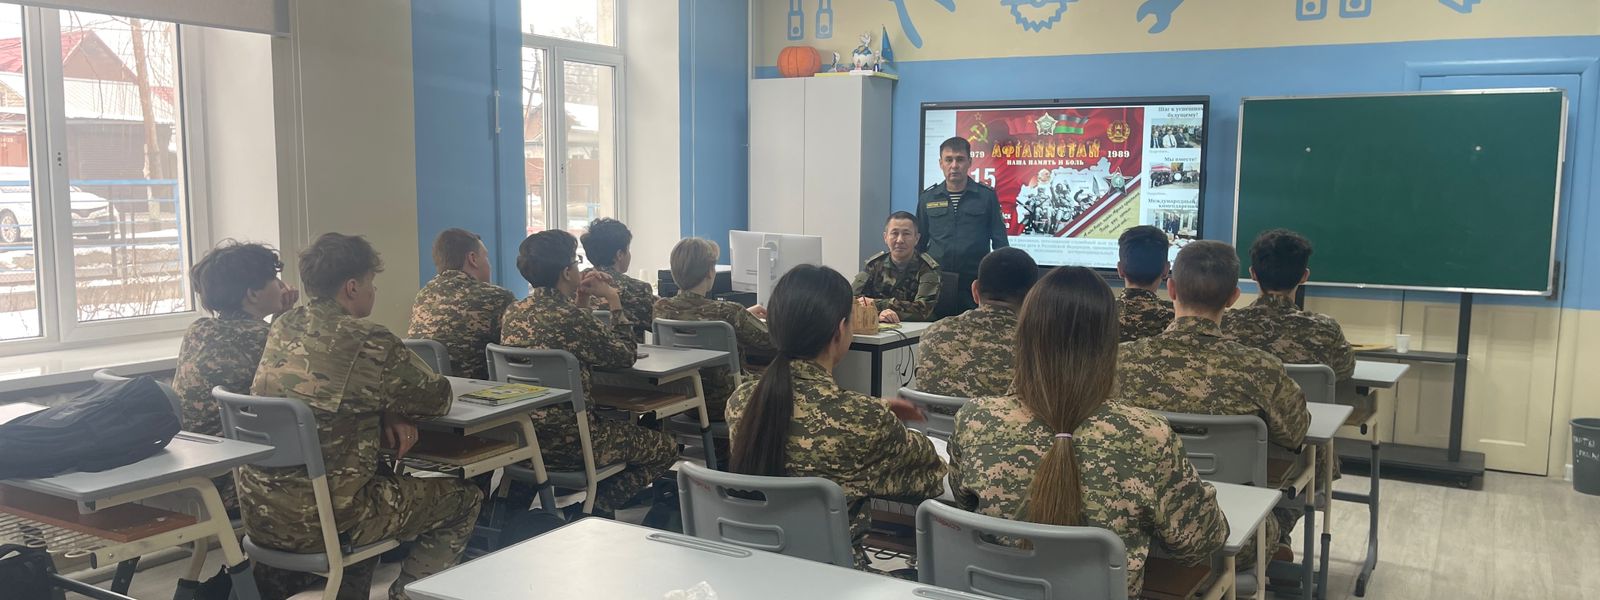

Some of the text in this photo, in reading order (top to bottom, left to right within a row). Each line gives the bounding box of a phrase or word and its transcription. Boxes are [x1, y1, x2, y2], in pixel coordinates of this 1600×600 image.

[991, 142, 1100, 158] АФГАНИСТАН
[1107, 150, 1130, 158] 1989
[971, 168, 996, 188] 15
